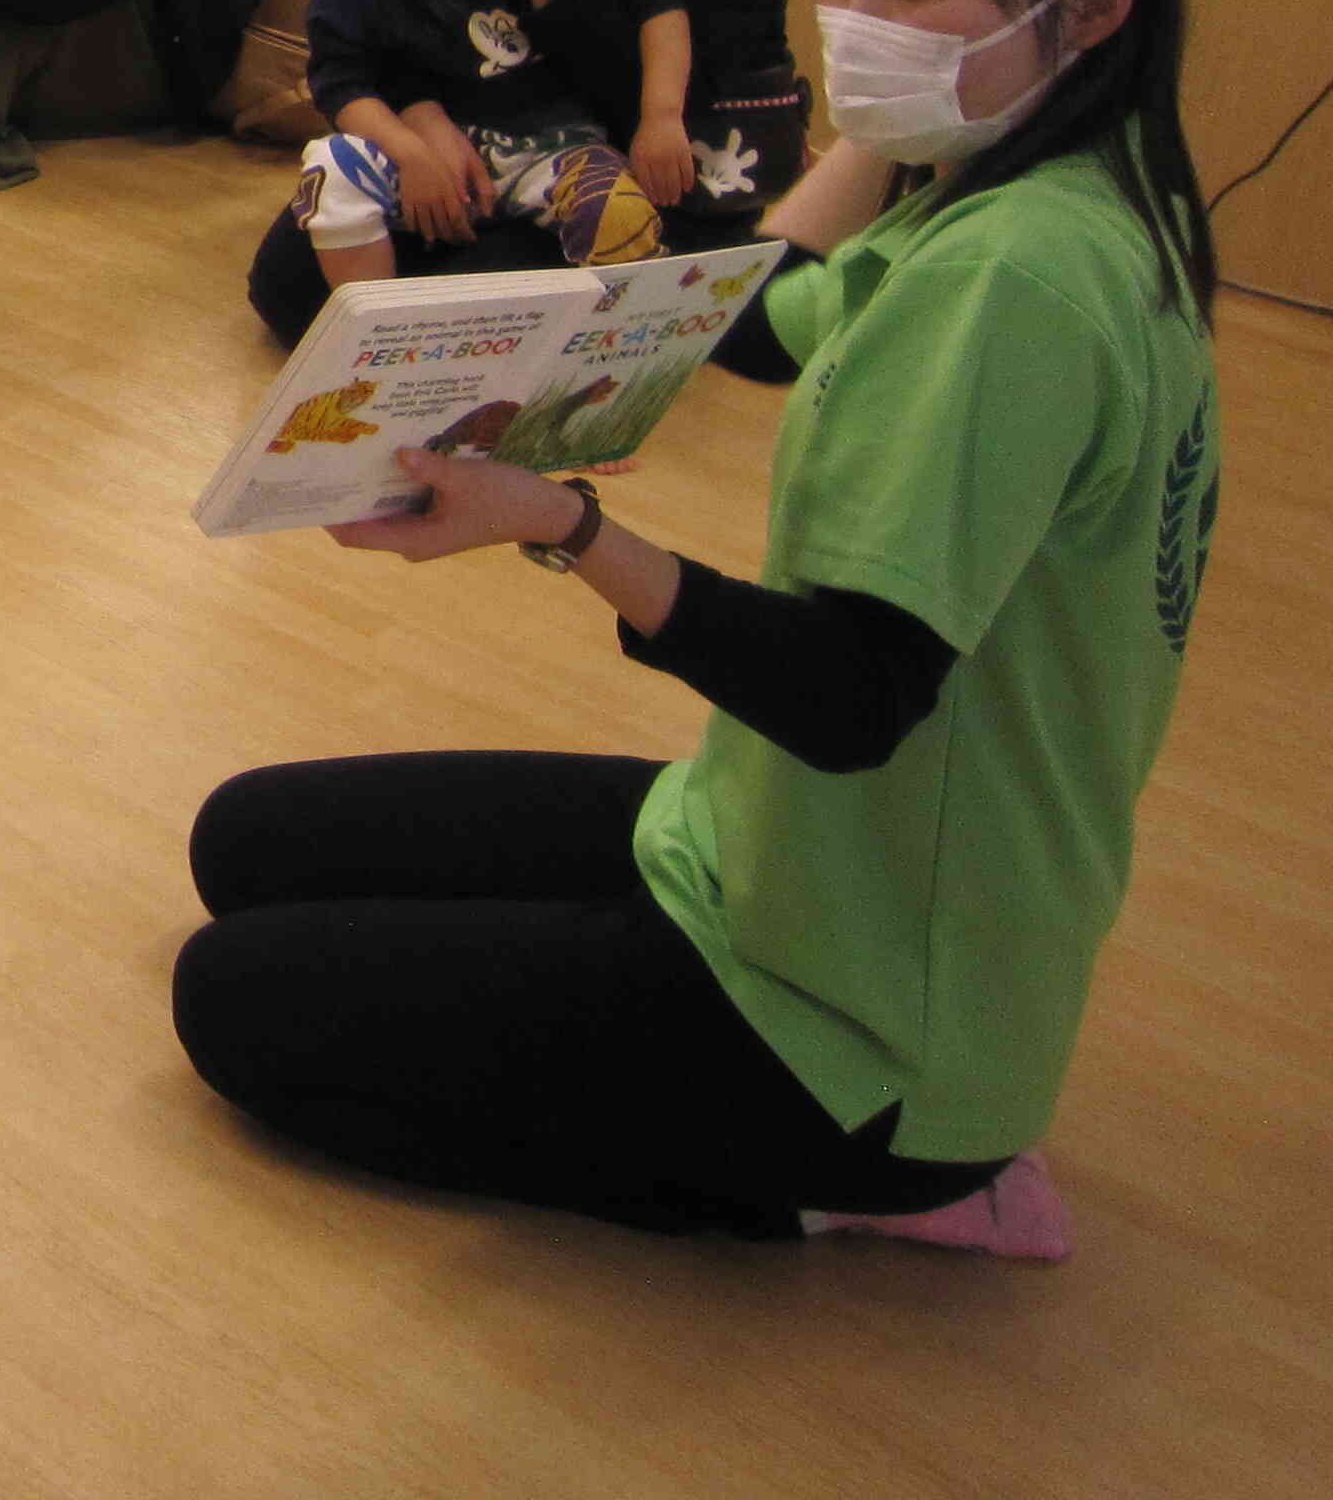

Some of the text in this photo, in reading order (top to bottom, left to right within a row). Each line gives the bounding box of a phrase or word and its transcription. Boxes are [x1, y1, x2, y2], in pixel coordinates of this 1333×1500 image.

[561, 309, 727, 356] EEK-A-BOO
[351, 337, 523, 368] PEEK-A-BOO!
[584, 344, 661, 365] ANIMALS
